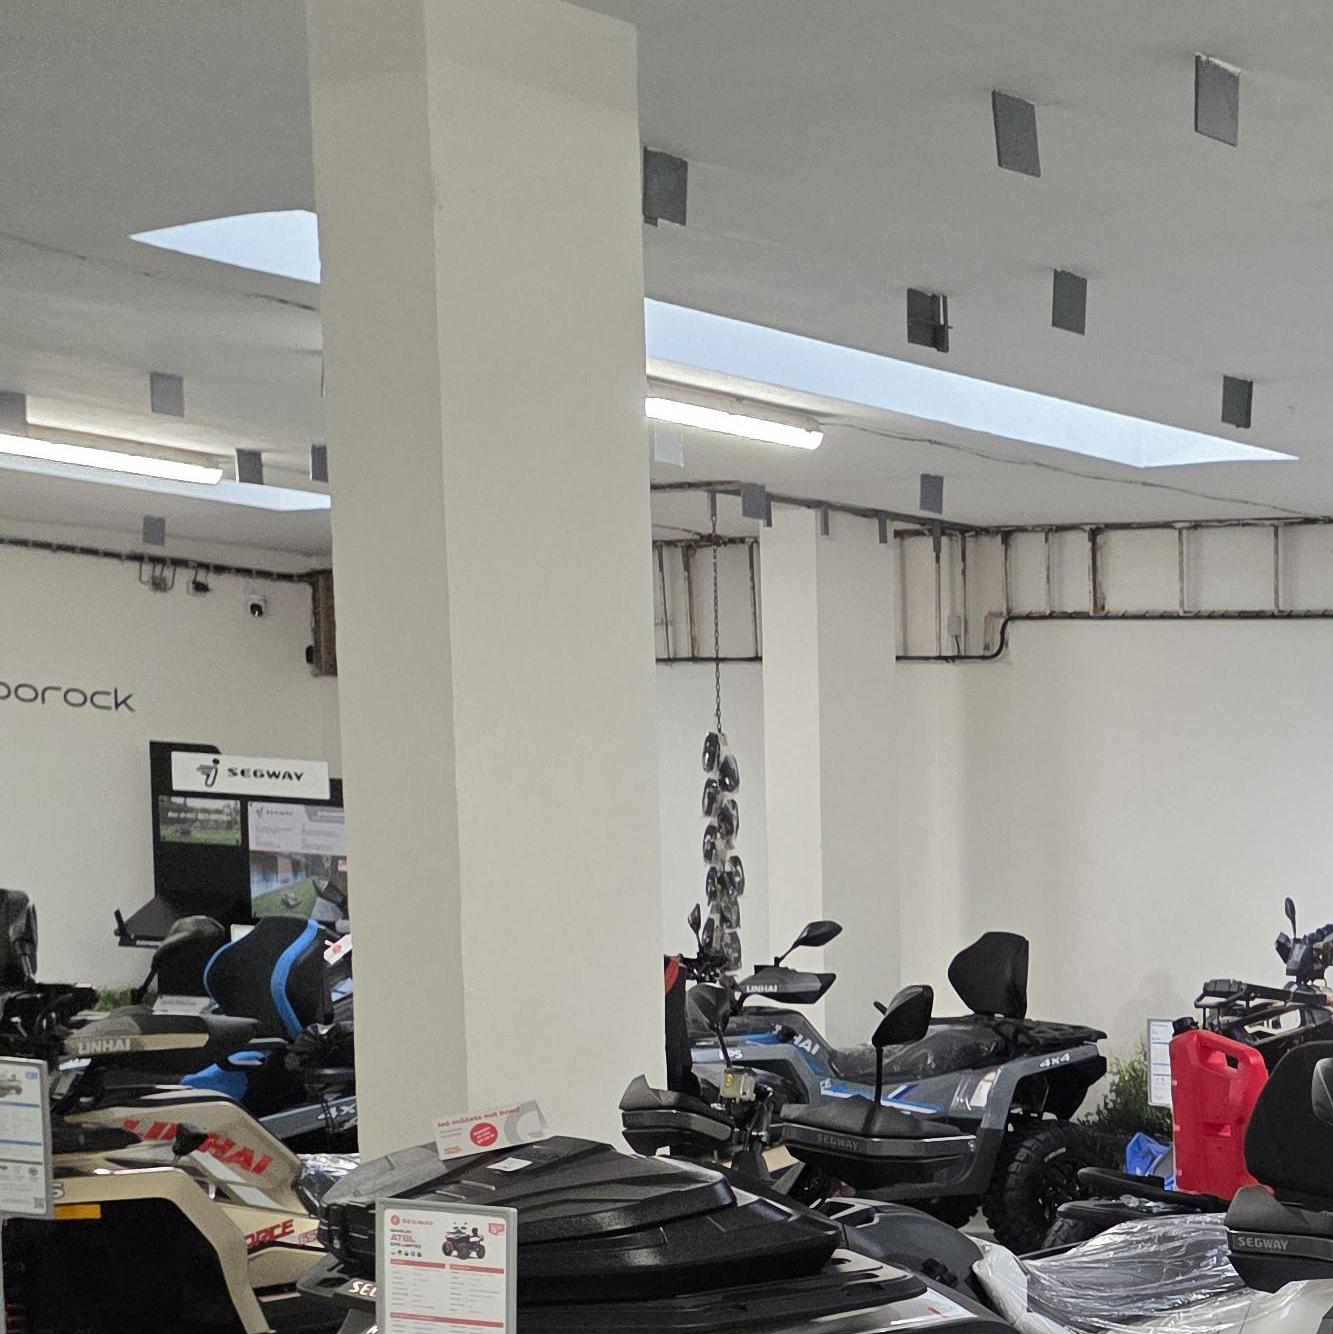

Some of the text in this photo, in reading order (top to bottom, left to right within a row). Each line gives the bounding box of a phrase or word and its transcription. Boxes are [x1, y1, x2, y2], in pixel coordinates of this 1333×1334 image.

[227, 766, 305, 783] SEGWAY
[746, 983, 778, 994] LINHAI
[79, 1038, 131, 1053] LINHAI
[1237, 1235, 1289, 1251] SEGWAY
